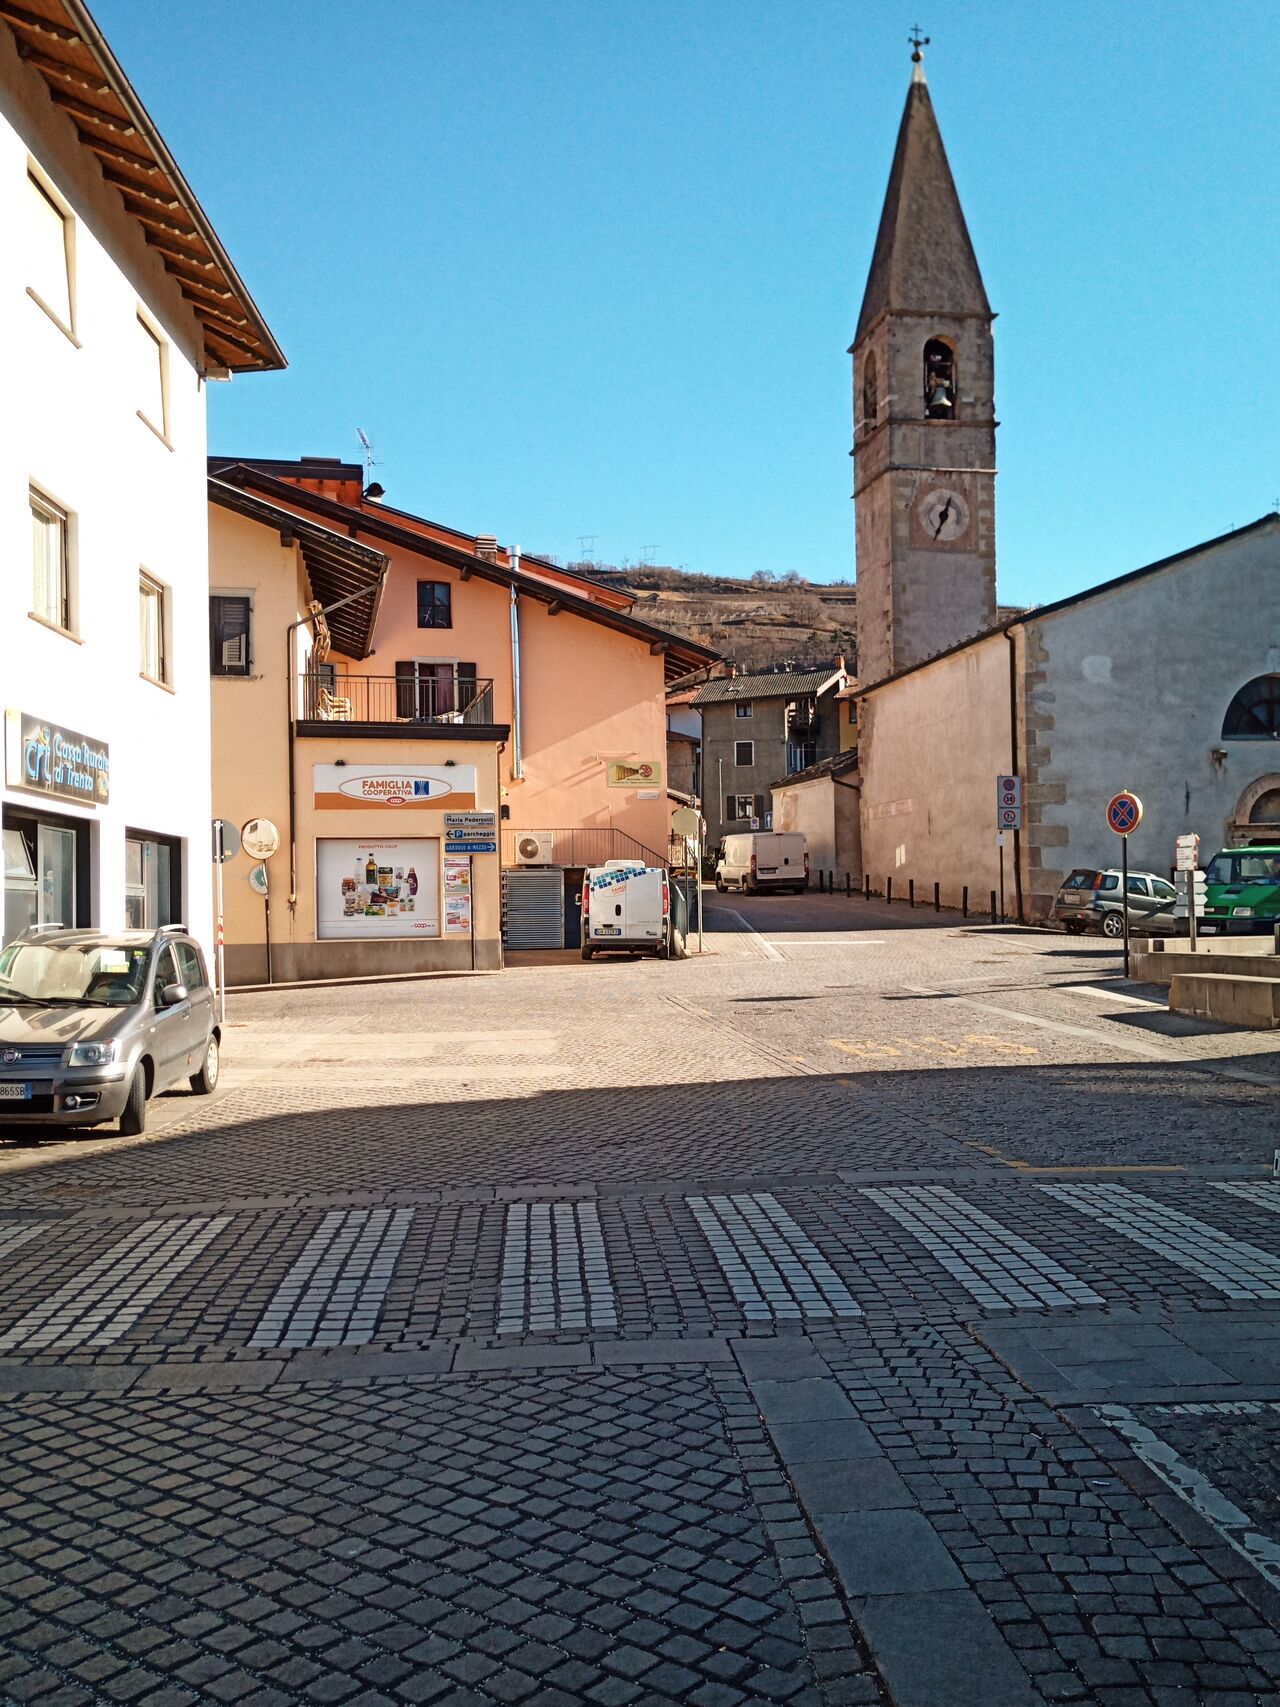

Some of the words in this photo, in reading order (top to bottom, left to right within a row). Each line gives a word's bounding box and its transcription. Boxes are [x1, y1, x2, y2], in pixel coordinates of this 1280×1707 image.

[26, 741, 52, 782] crt
[55, 735, 82, 763] Cassa
[55, 761, 64, 784] di
[65, 763, 94, 791] Trento
[362, 780, 412, 789] FAMIGLIA
